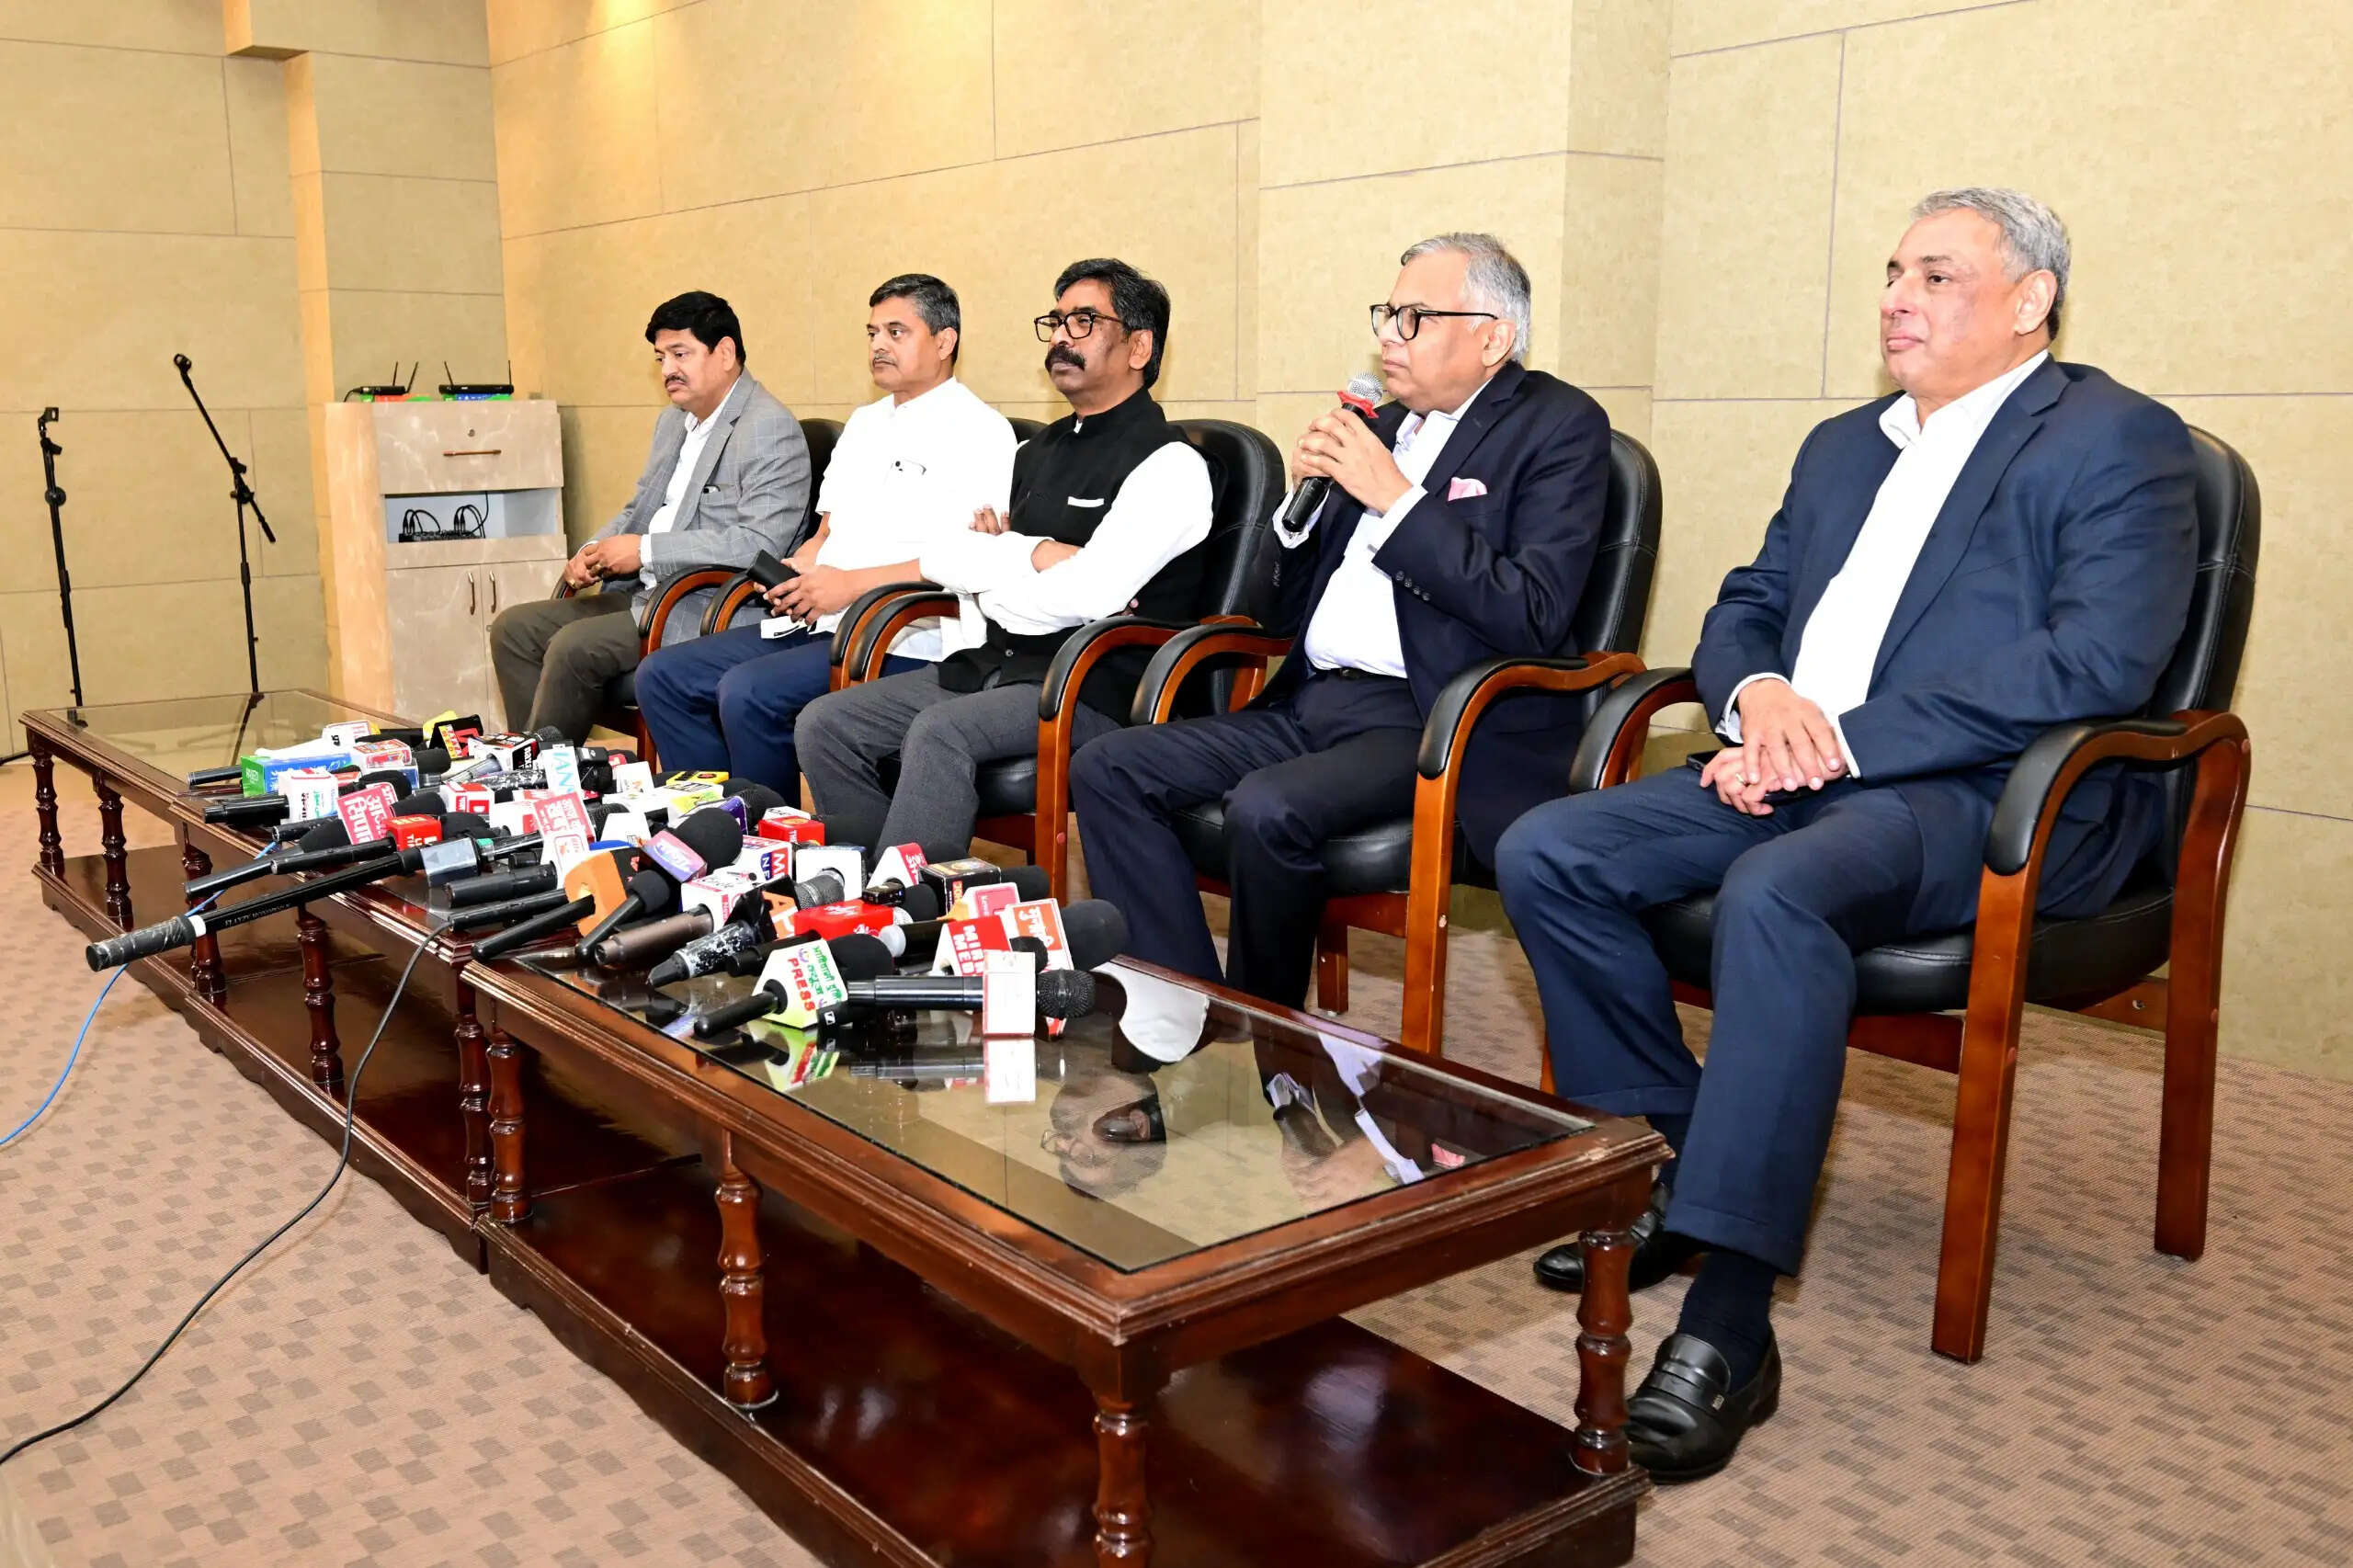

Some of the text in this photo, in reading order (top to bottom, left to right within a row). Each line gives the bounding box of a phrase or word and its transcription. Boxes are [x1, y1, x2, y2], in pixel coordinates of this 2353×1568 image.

[552, 752, 575, 793] IAN
[344, 795, 373, 844] सिपा
[788, 957, 816, 1011] PRESS
